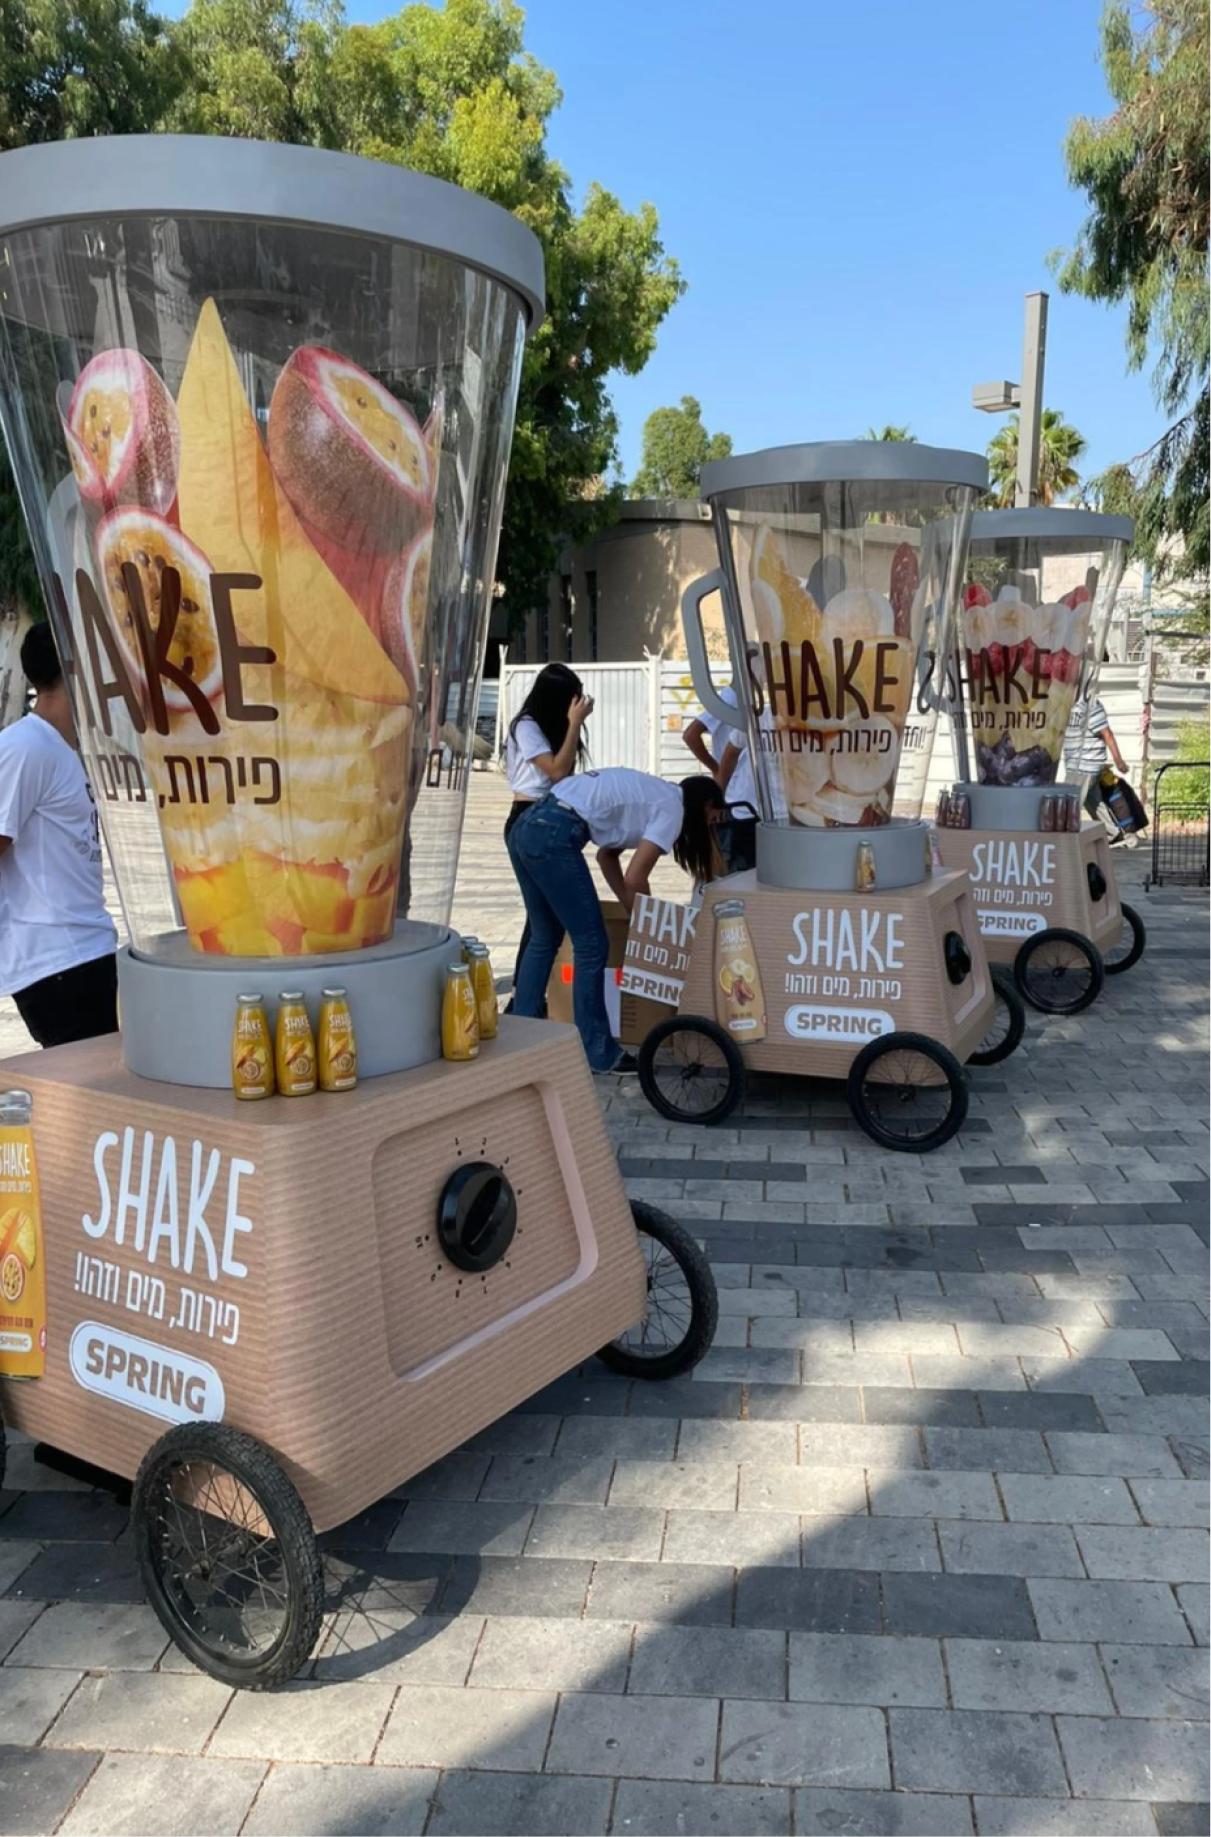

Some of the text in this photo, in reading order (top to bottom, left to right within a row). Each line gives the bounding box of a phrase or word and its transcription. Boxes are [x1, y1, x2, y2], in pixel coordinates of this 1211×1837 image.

[746, 638, 899, 720] SHAKE
[947, 645, 1051, 705] SHAKE
[789, 729, 824, 752] מים
[830, 729, 892, 756] פירות,
[159, 755, 282, 809] פירות,
[968, 840, 1057, 888] SHAKE
[630, 895, 699, 948] HAK
[994, 888, 1015, 905] מים
[1016, 890, 1053, 907] פירות,
[643, 944, 668, 966] מים
[787, 908, 905, 973] SHAKE
[785, 972, 902, 1000] פירות, מים וזהו!
[797, 1012, 882, 1035] SPRING
[81, 1125, 256, 1281] SHAKE
[74, 1251, 240, 1345] פירות, מים וזהו!
[85, 1338, 207, 1415] SPRING
